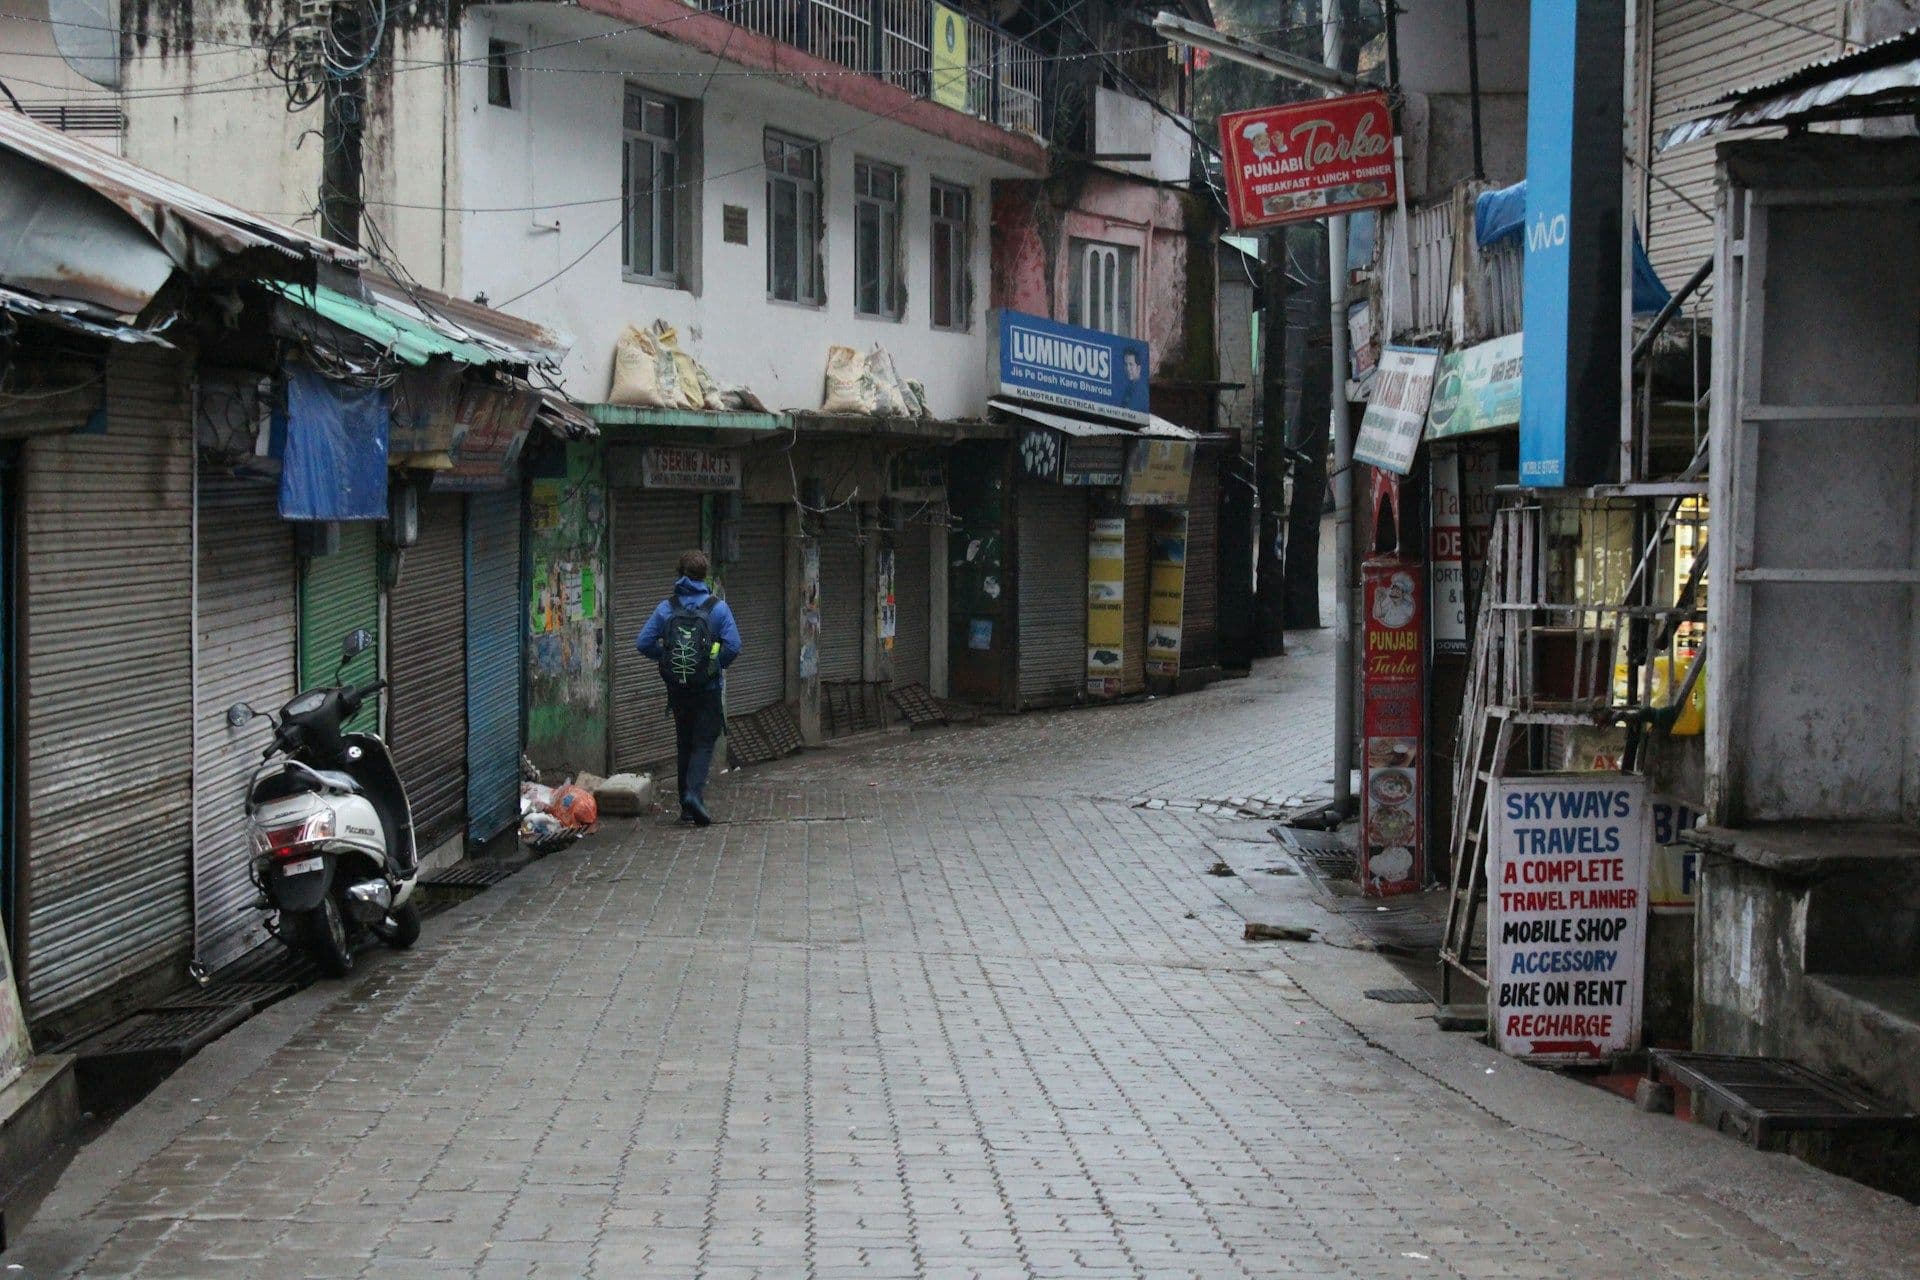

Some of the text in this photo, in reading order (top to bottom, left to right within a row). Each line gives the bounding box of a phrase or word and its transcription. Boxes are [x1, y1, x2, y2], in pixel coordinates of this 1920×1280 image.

[1290, 112, 1391, 171] Tarka
[1243, 156, 1303, 180] PUNJABI
[1013, 331, 1110, 379] LUMINOUS
[1024, 368, 1036, 380] Pe
[1037, 371, 1058, 384] Desh
[1059, 376, 1079, 390] Kare
[1080, 381, 1112, 397] Bharosa
[1016, 387, 1096, 411] KALMOTRA ELECTRICAL
[655, 449, 731, 473] TSERING ARTS
[1369, 631, 1417, 651] PUNJABI
[1369, 655, 1417, 674] Tarka
[1506, 791, 1630, 820] SKYWAYS
[1514, 827, 1619, 855] TRAVELS
[1504, 858, 1624, 884] A COMPLETE
[1500, 888, 1638, 912] TRAVEL PLANNER
[1502, 917, 1627, 944] MOBILE SHOP
[1511, 951, 1618, 974] ACCESSORY
[1499, 980, 1627, 1007] BIKE ON RENT
[1506, 1014, 1612, 1037] RECHARGE
